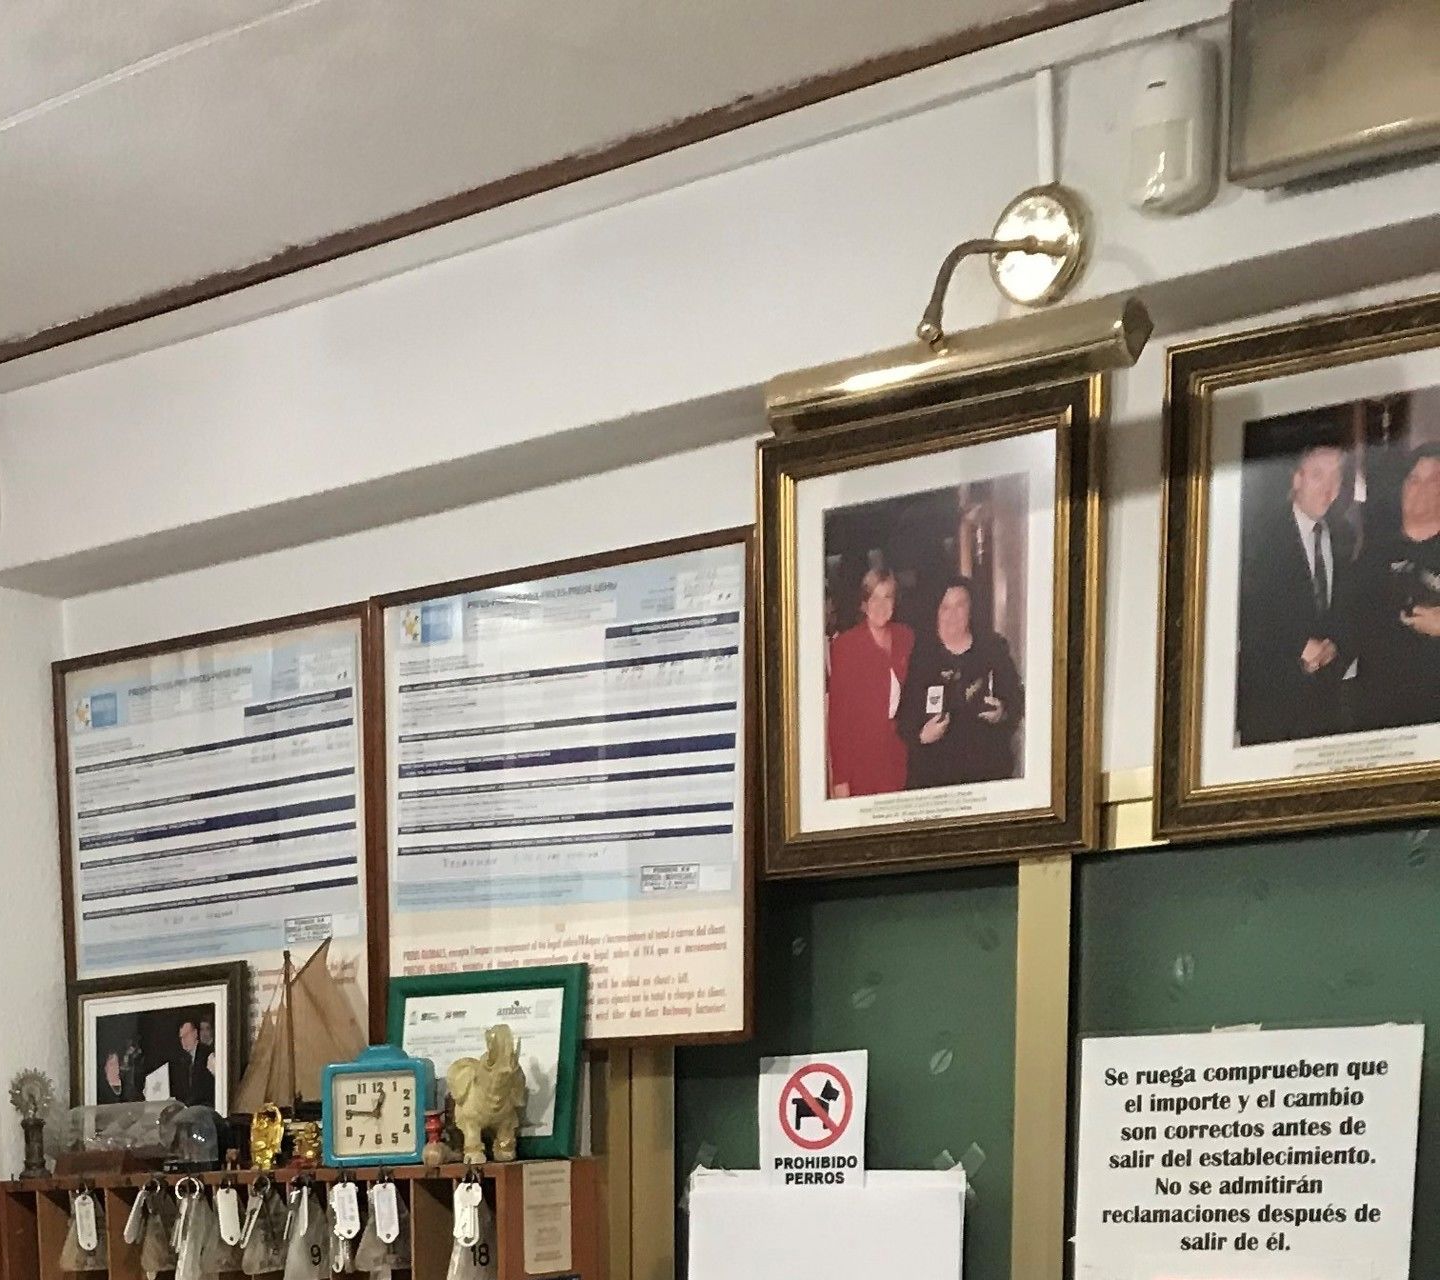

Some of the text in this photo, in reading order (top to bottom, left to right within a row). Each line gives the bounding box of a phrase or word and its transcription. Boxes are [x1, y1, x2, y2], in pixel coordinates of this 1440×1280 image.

[1105, 1059, 1388, 1088] Se ruega comprueben que
[358, 1081, 396, 1093] 11 12 1
[403, 1089, 410, 1099] 2
[1125, 1088, 1364, 1114] el importe y el cambio
[403, 1106, 410, 1117] 3
[403, 1124, 410, 1133] 4
[1121, 1117, 1366, 1141] son correctos antes de
[359, 1133, 398, 1146] 7 6 5
[775, 1156, 857, 1169] PROHIBIDO
[1110, 1148, 1376, 1168] salir del establecimiento.
[786, 1172, 844, 1184] PERROS
[1155, 1175, 1323, 1195] No se admitirán
[1102, 1203, 1381, 1226] reclamaciones después de
[1181, 1231, 1290, 1251] salir de él.
[311, 1246, 321, 1265] 9
[470, 1244, 489, 1265] 18
